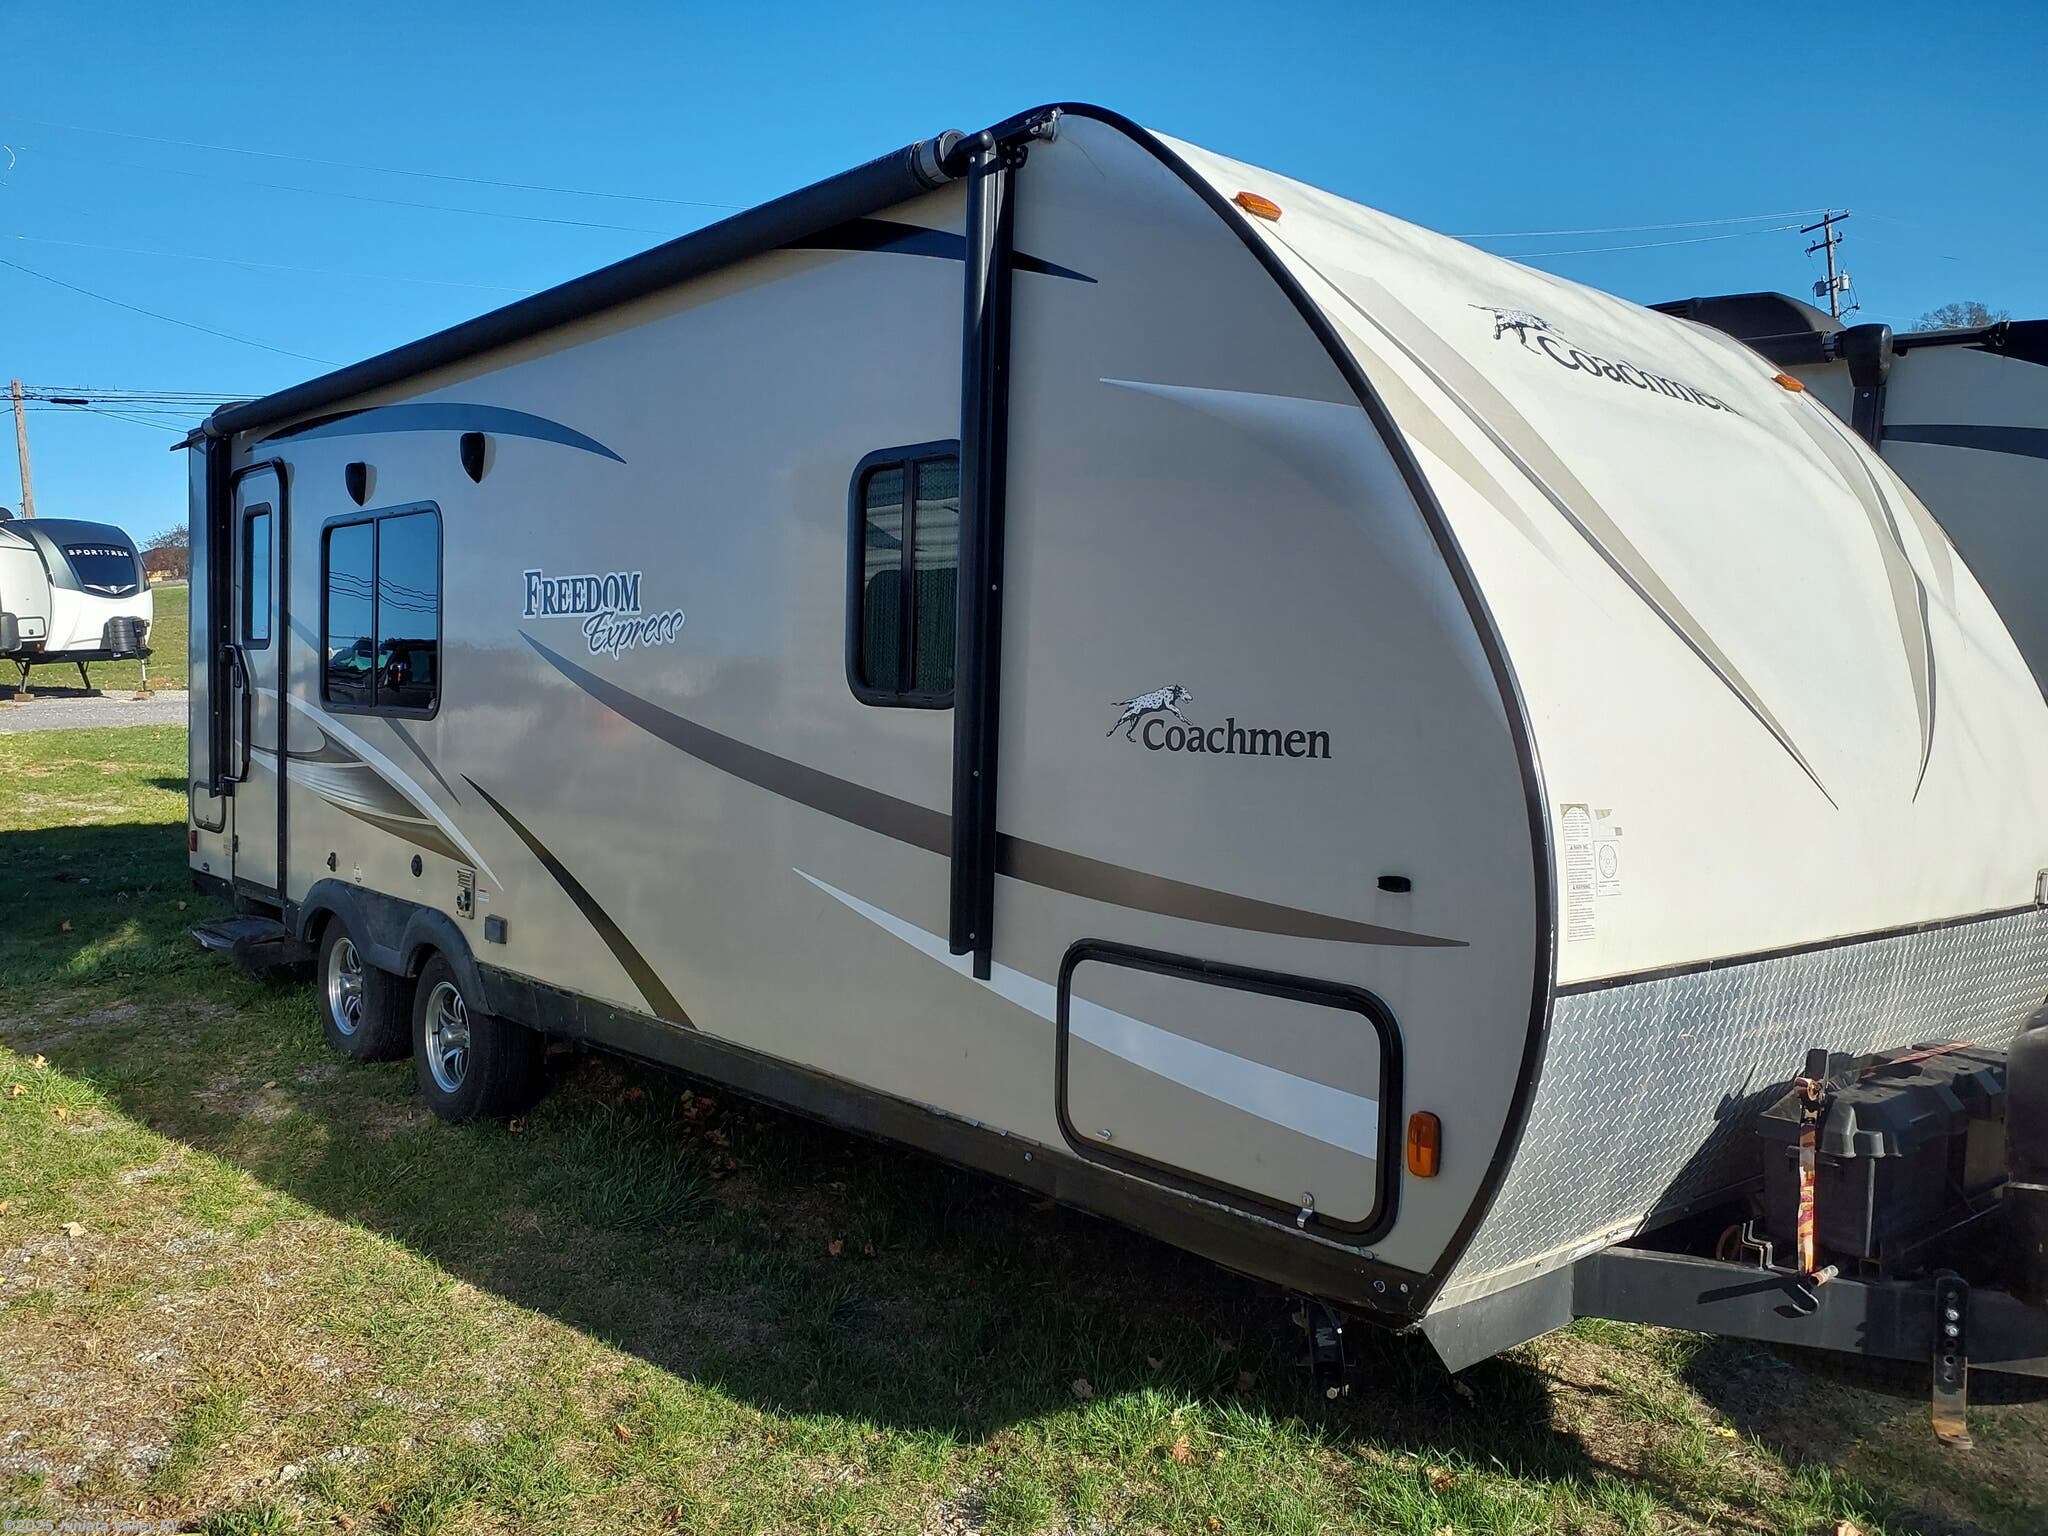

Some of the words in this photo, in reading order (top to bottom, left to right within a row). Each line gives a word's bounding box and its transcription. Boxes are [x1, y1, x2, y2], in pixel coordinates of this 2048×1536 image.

[68, 549, 129, 557] SPORTTREK
[524, 569, 642, 618] FREEDOM
[583, 608, 685, 660] Express
[1143, 717, 1332, 759] Coachmen
